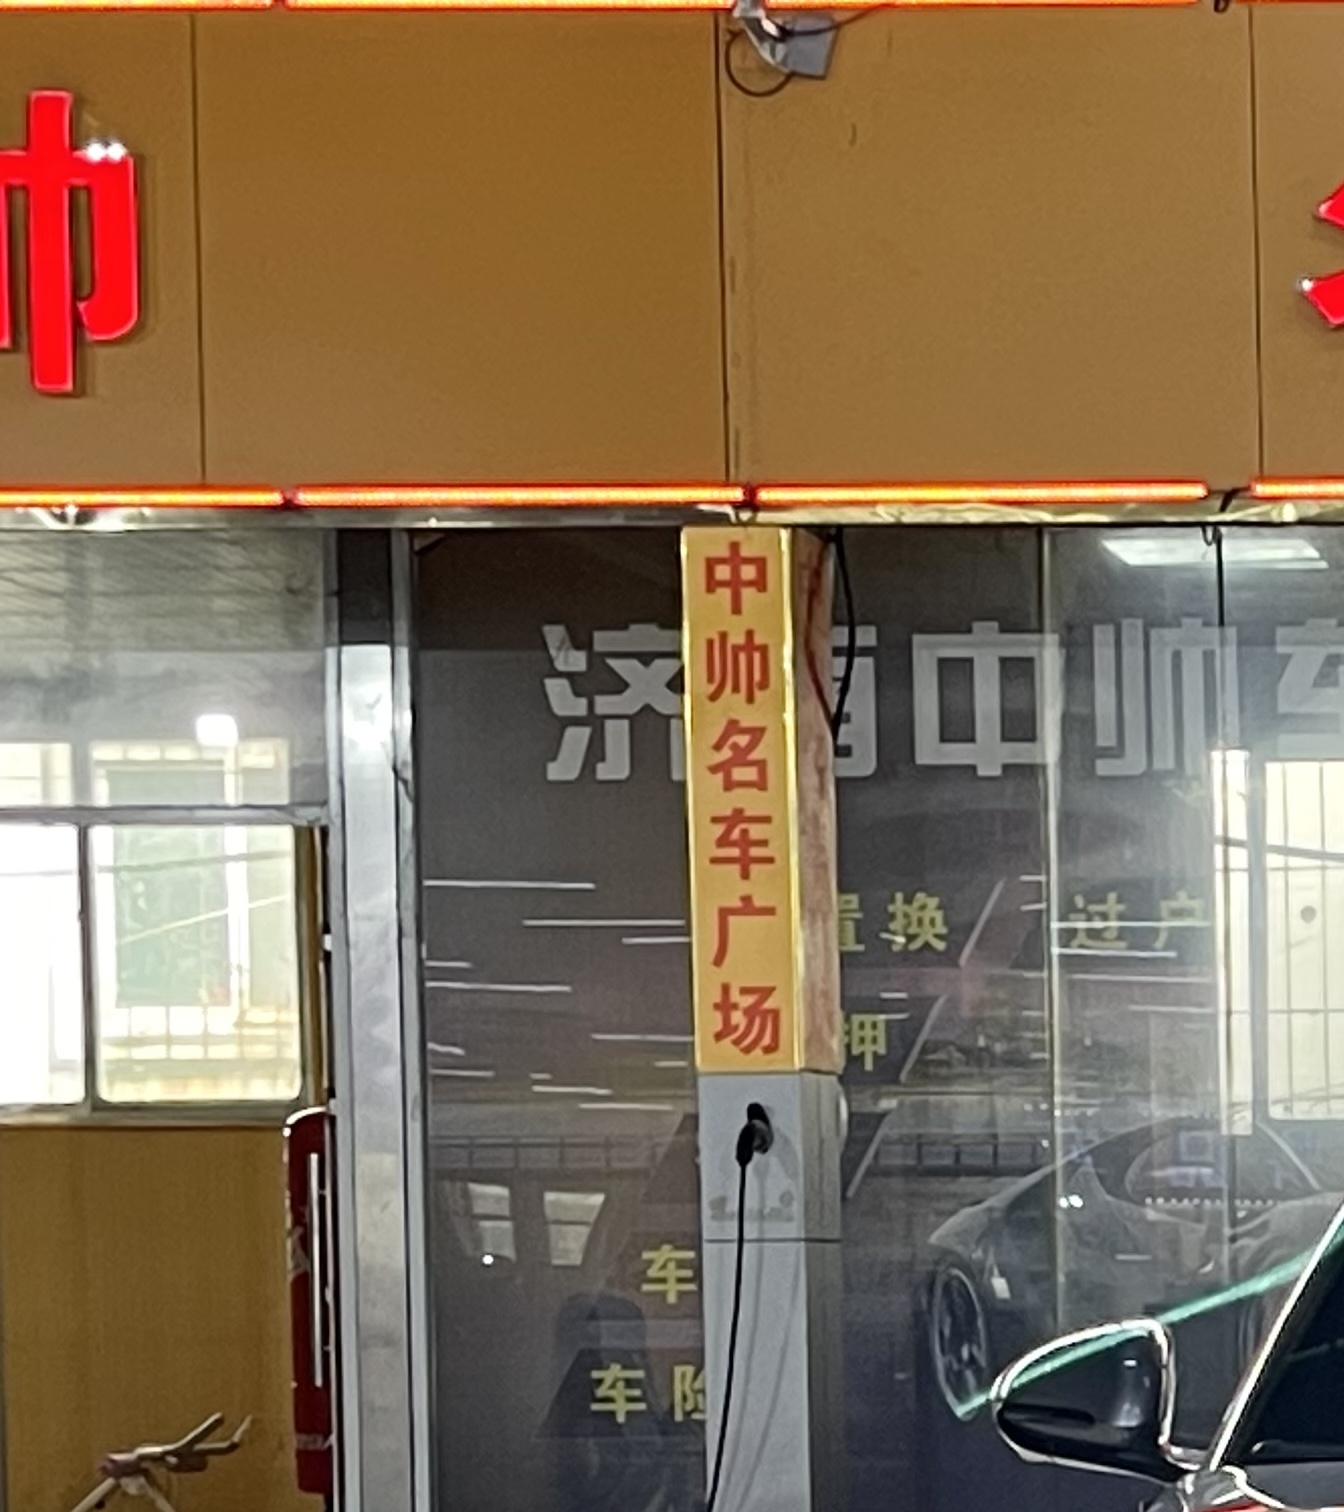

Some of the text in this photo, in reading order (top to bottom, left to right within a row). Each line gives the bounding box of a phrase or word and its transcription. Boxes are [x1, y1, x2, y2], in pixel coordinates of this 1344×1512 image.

[705, 543, 780, 1053] 中帅名车广场
